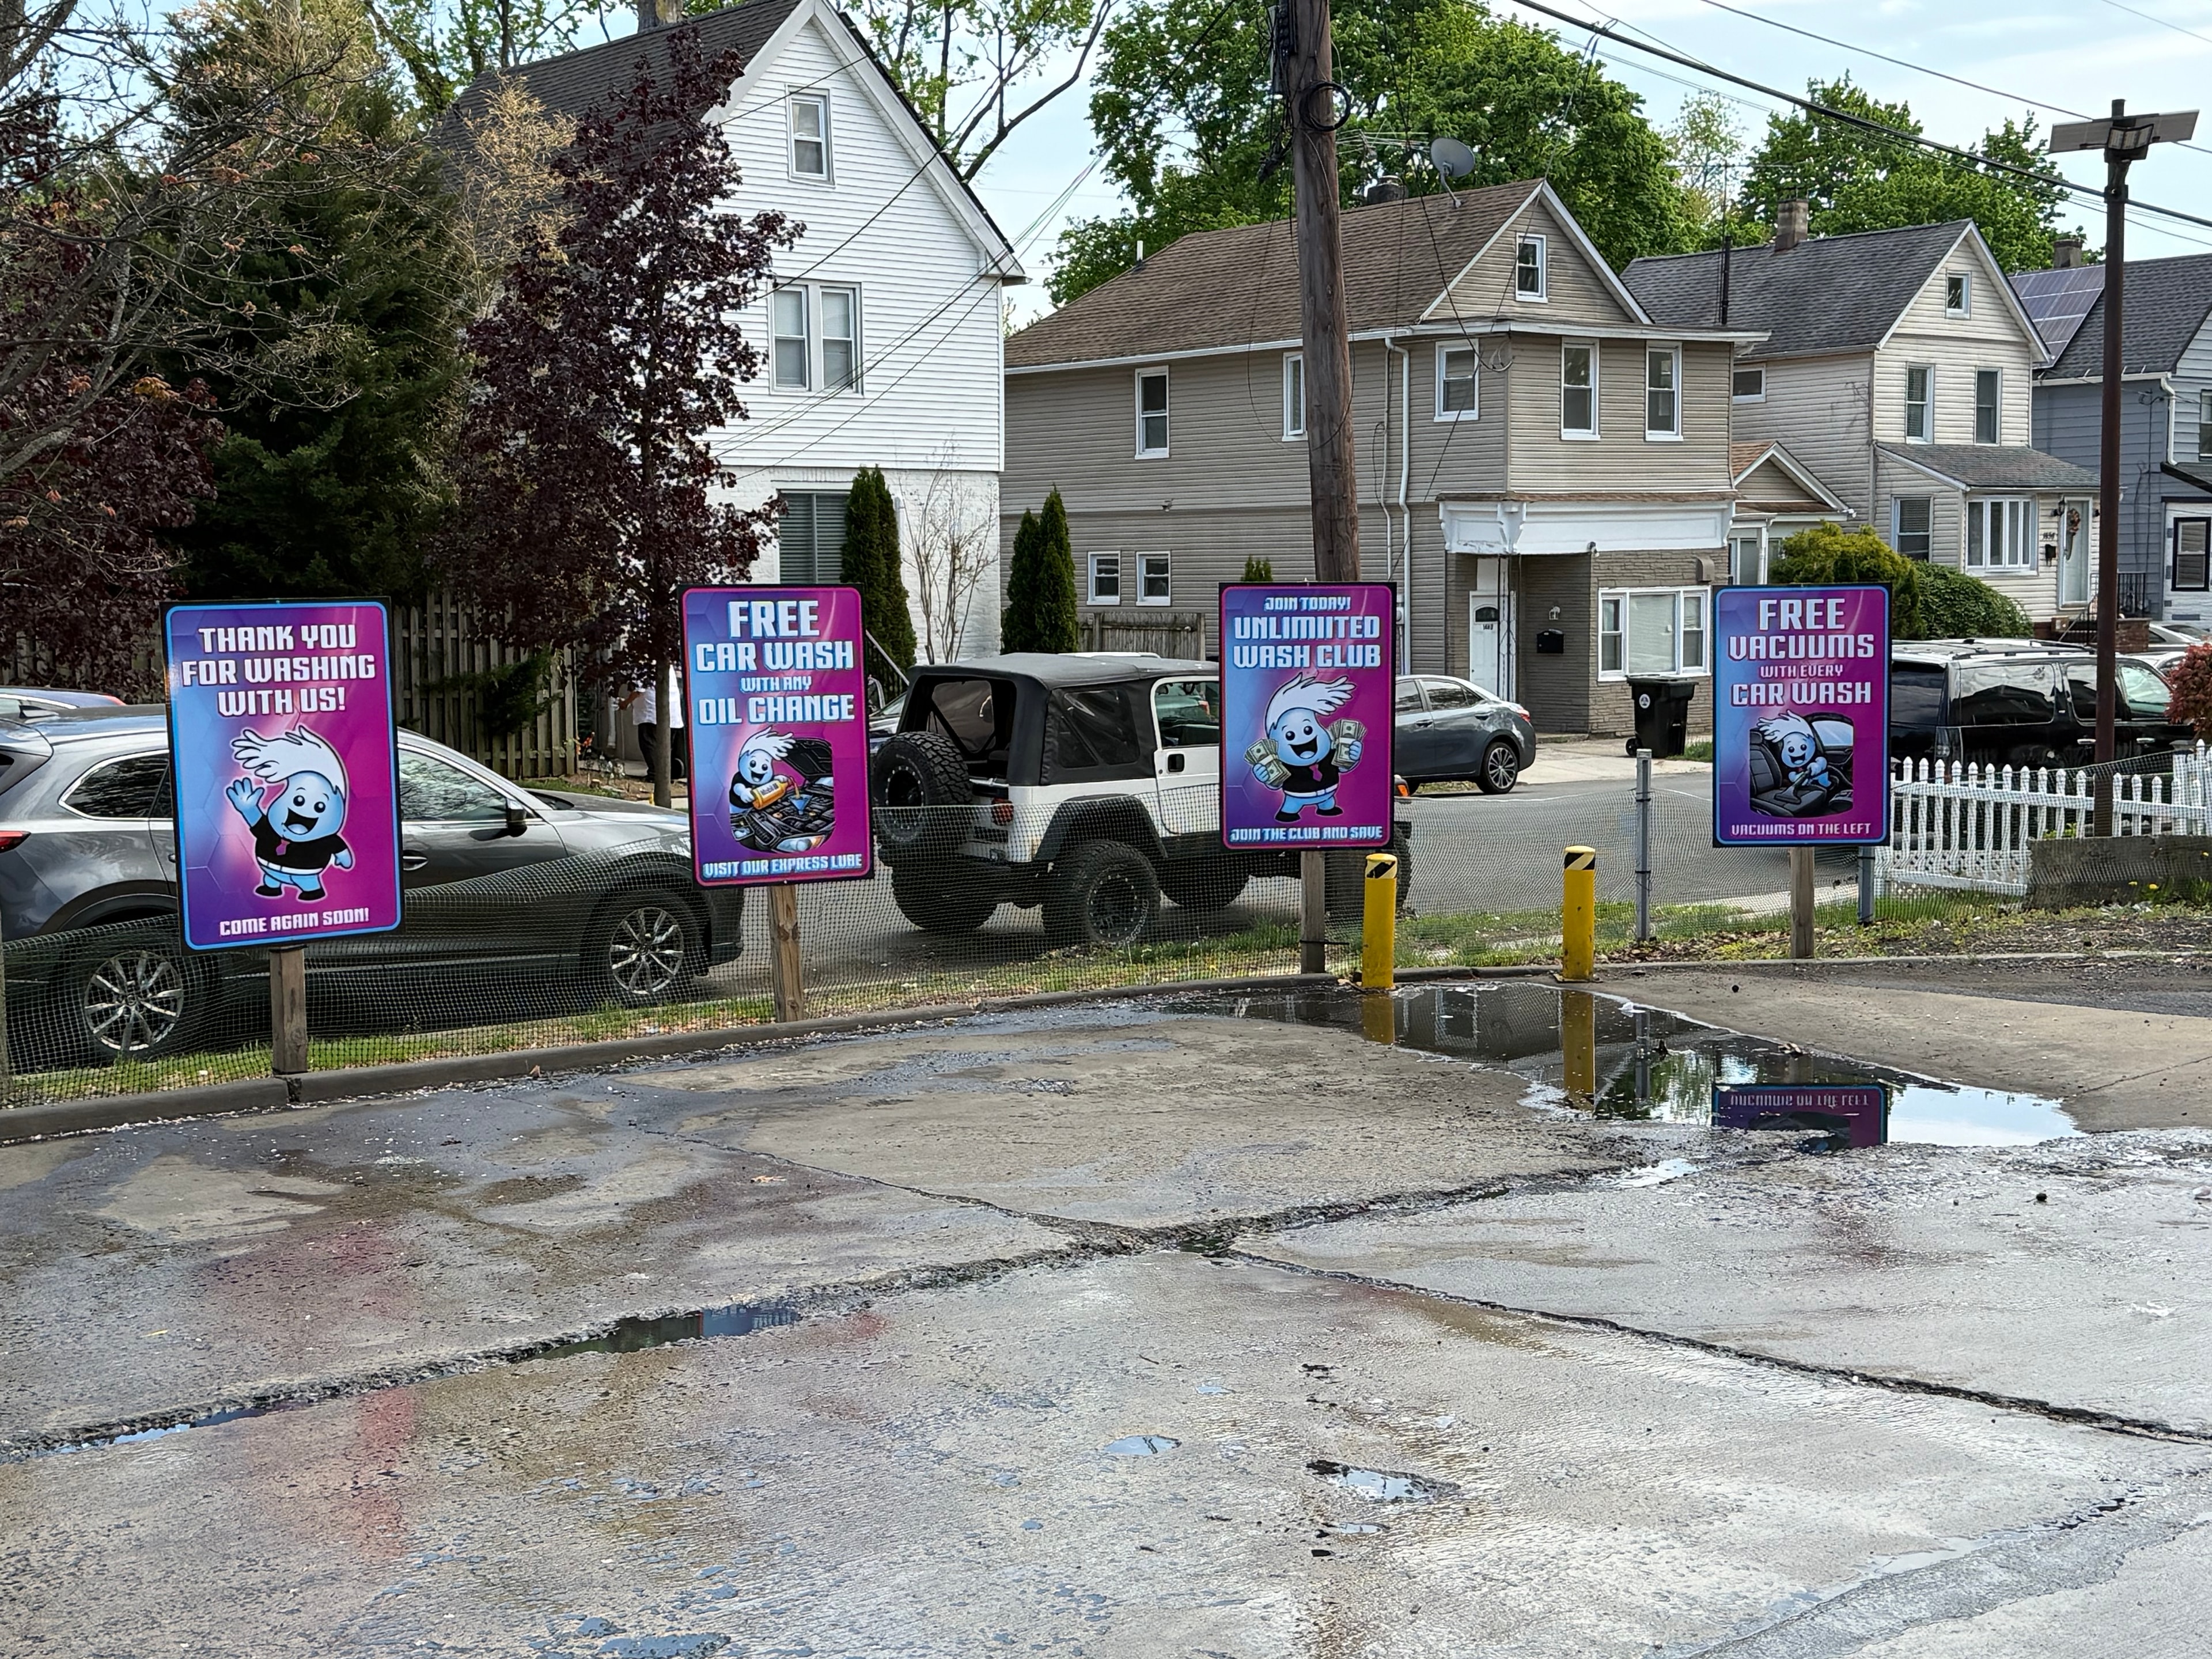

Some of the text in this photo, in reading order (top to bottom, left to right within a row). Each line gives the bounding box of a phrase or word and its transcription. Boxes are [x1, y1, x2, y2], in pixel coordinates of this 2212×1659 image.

[1264, 596, 1351, 612] JOIN TODAY!
[1759, 598, 1846, 631] FREE
[728, 600, 820, 638] FREE
[198, 624, 356, 653] THANK YOU
[1729, 634, 1874, 660] VACUUMS
[696, 641, 854, 672] CAR WASH
[1233, 644, 1381, 668] WASH CLUB
[182, 654, 376, 686] FOR WASHING
[1760, 664, 1843, 679] WITH EVERY
[740, 676, 812, 693] WITH ANY
[1732, 681, 1872, 707] CAR WASH
[218, 687, 346, 717] WITH US!
[698, 695, 855, 725] OIL CHANGE
[1230, 826, 1382, 842] JOIN THE CLUB AND SAVE
[1731, 823, 1872, 836] VACUUMS ON THE LEFT
[703, 854, 862, 878] VISIT OUR EXPRESS LUBE
[219, 908, 369, 937] COME AGAIN SOON!
